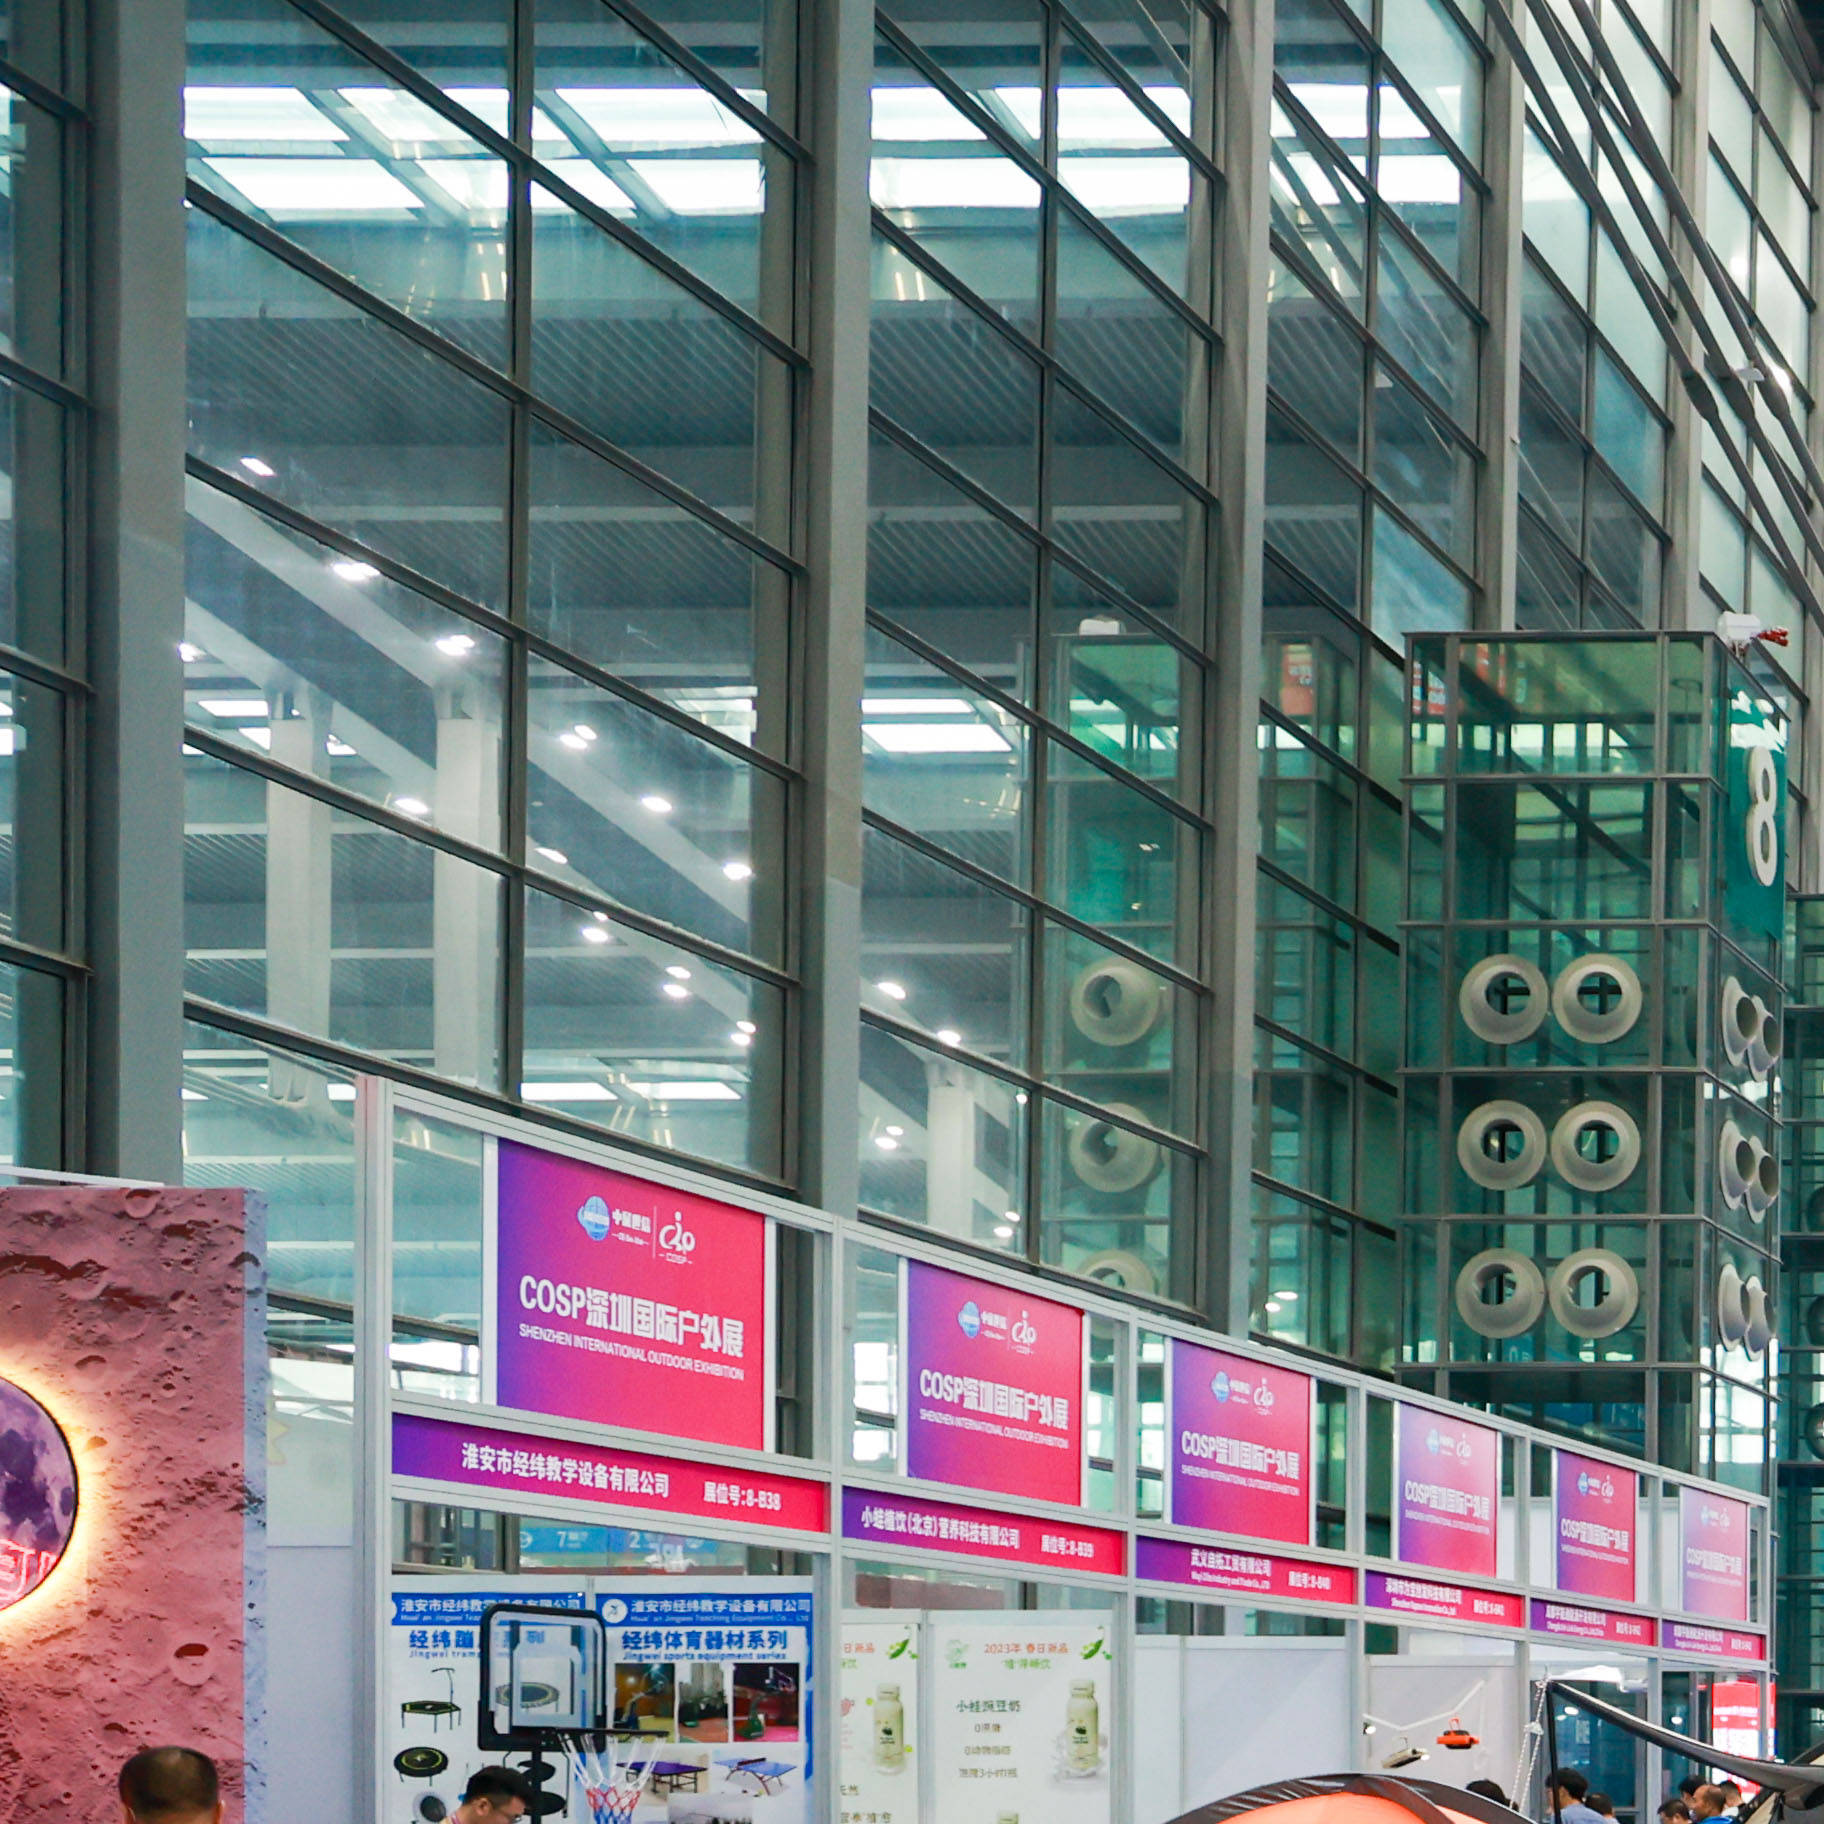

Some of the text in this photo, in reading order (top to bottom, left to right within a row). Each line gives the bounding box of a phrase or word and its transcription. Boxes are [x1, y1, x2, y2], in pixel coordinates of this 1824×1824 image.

[1747, 746, 1778, 887] 8
[519, 1275, 744, 1358] COSP深圳国际户外展
[519, 1323, 744, 1380] SHENZHEN INTERNATIONAL OUTDOOR EXHIBITION
[919, 1368, 1069, 1430] COSP深圳国际户外展
[461, 1442, 669, 1498] 淮安市经纬教学设备有限公司
[622, 1631, 787, 1650] 经纬体育器材系列
